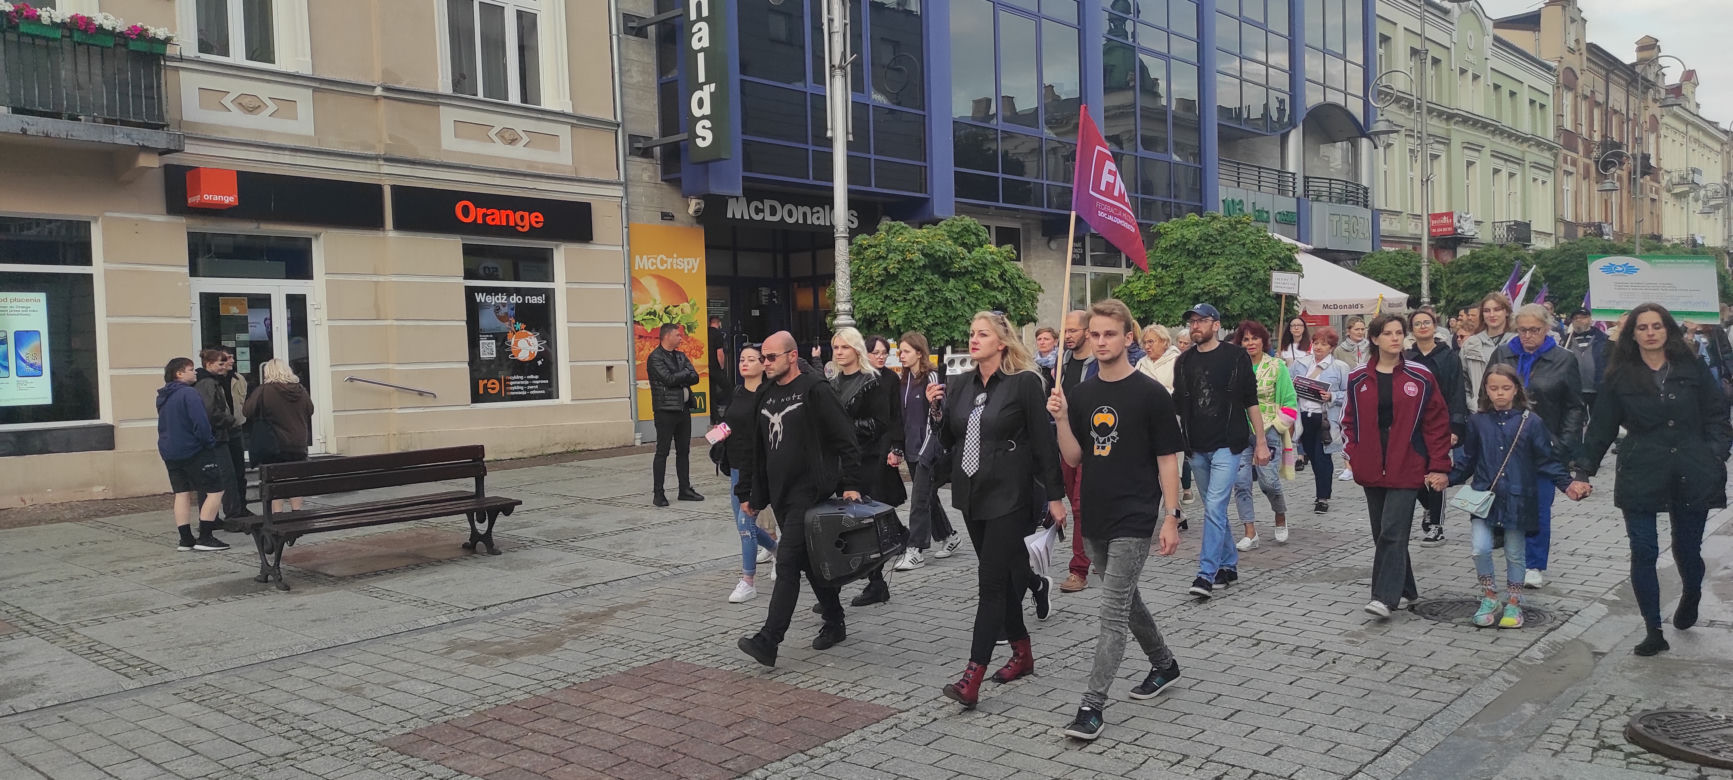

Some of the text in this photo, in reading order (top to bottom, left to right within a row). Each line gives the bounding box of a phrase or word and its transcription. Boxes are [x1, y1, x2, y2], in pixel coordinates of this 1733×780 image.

[203, 193, 235, 204] orange
[455, 200, 544, 232] Orange
[727, 196, 859, 229] McDonals
[634, 252, 701, 273] McCrispy
[474, 292, 546, 305] Wejdź do nas!
[1322, 303, 1364, 311] McDonald's
